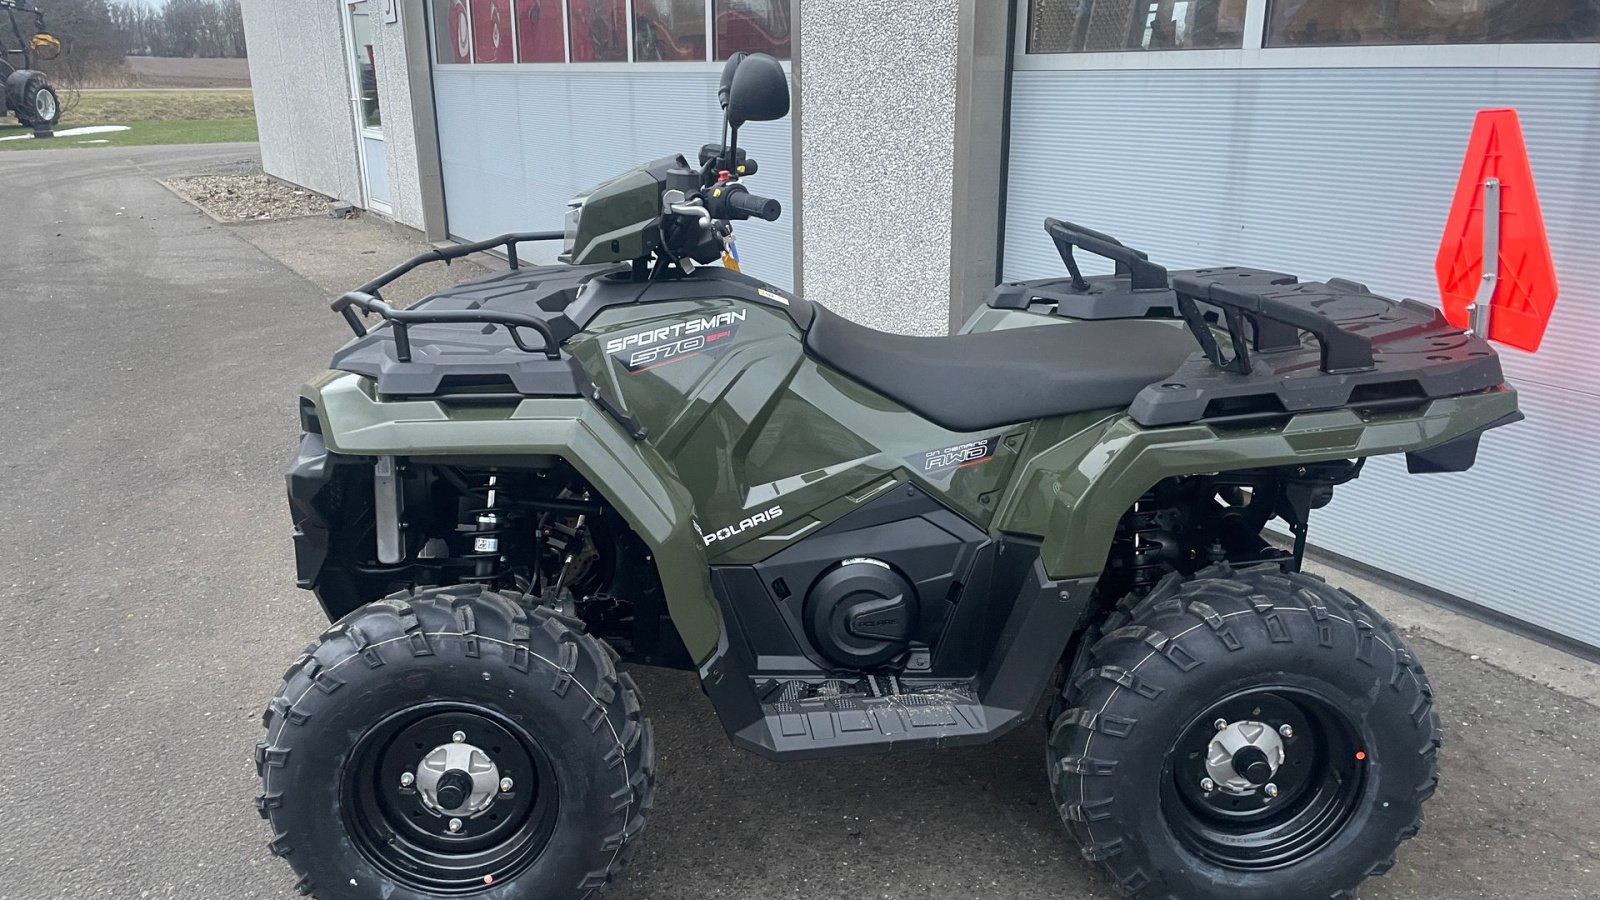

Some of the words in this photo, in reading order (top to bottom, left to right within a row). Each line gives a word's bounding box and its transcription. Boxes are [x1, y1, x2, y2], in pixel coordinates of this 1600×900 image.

[606, 309, 746, 354] SPORTSMAN
[629, 335, 705, 367] 570
[925, 445, 988, 470] AWD
[944, 440, 988, 453] DEMAND
[702, 505, 784, 547] POLARIS
